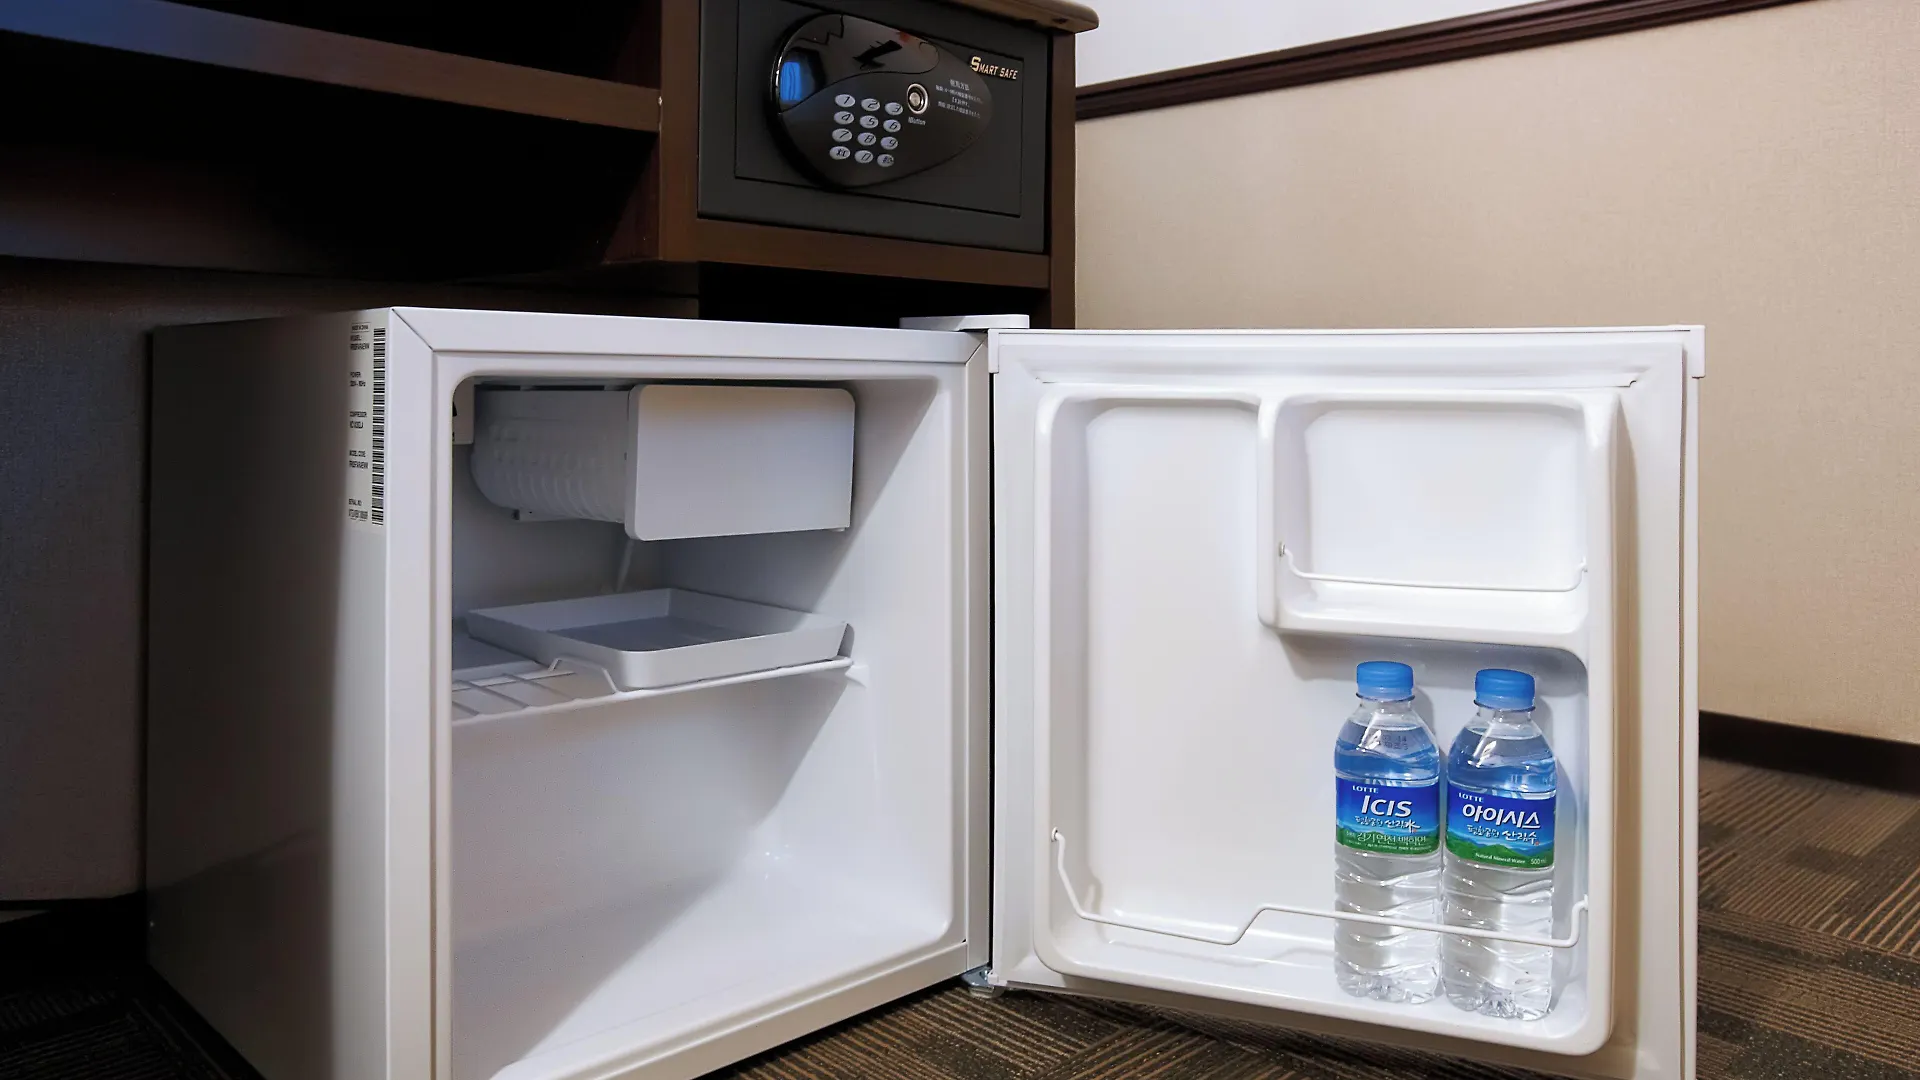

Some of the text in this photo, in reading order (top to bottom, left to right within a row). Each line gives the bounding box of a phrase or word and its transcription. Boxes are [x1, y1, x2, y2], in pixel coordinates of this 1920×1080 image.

[970, 56, 1018, 80] SMART SAFE
[1352, 785, 1378, 794] LOTTE
[1458, 792, 1484, 802] LOTTE
[1462, 804, 1541, 829] 아이시스
[1502, 829, 1538, 846] 산림수
[1475, 852, 1492, 860] Natural
[1493, 855, 1511, 863] Mineral
